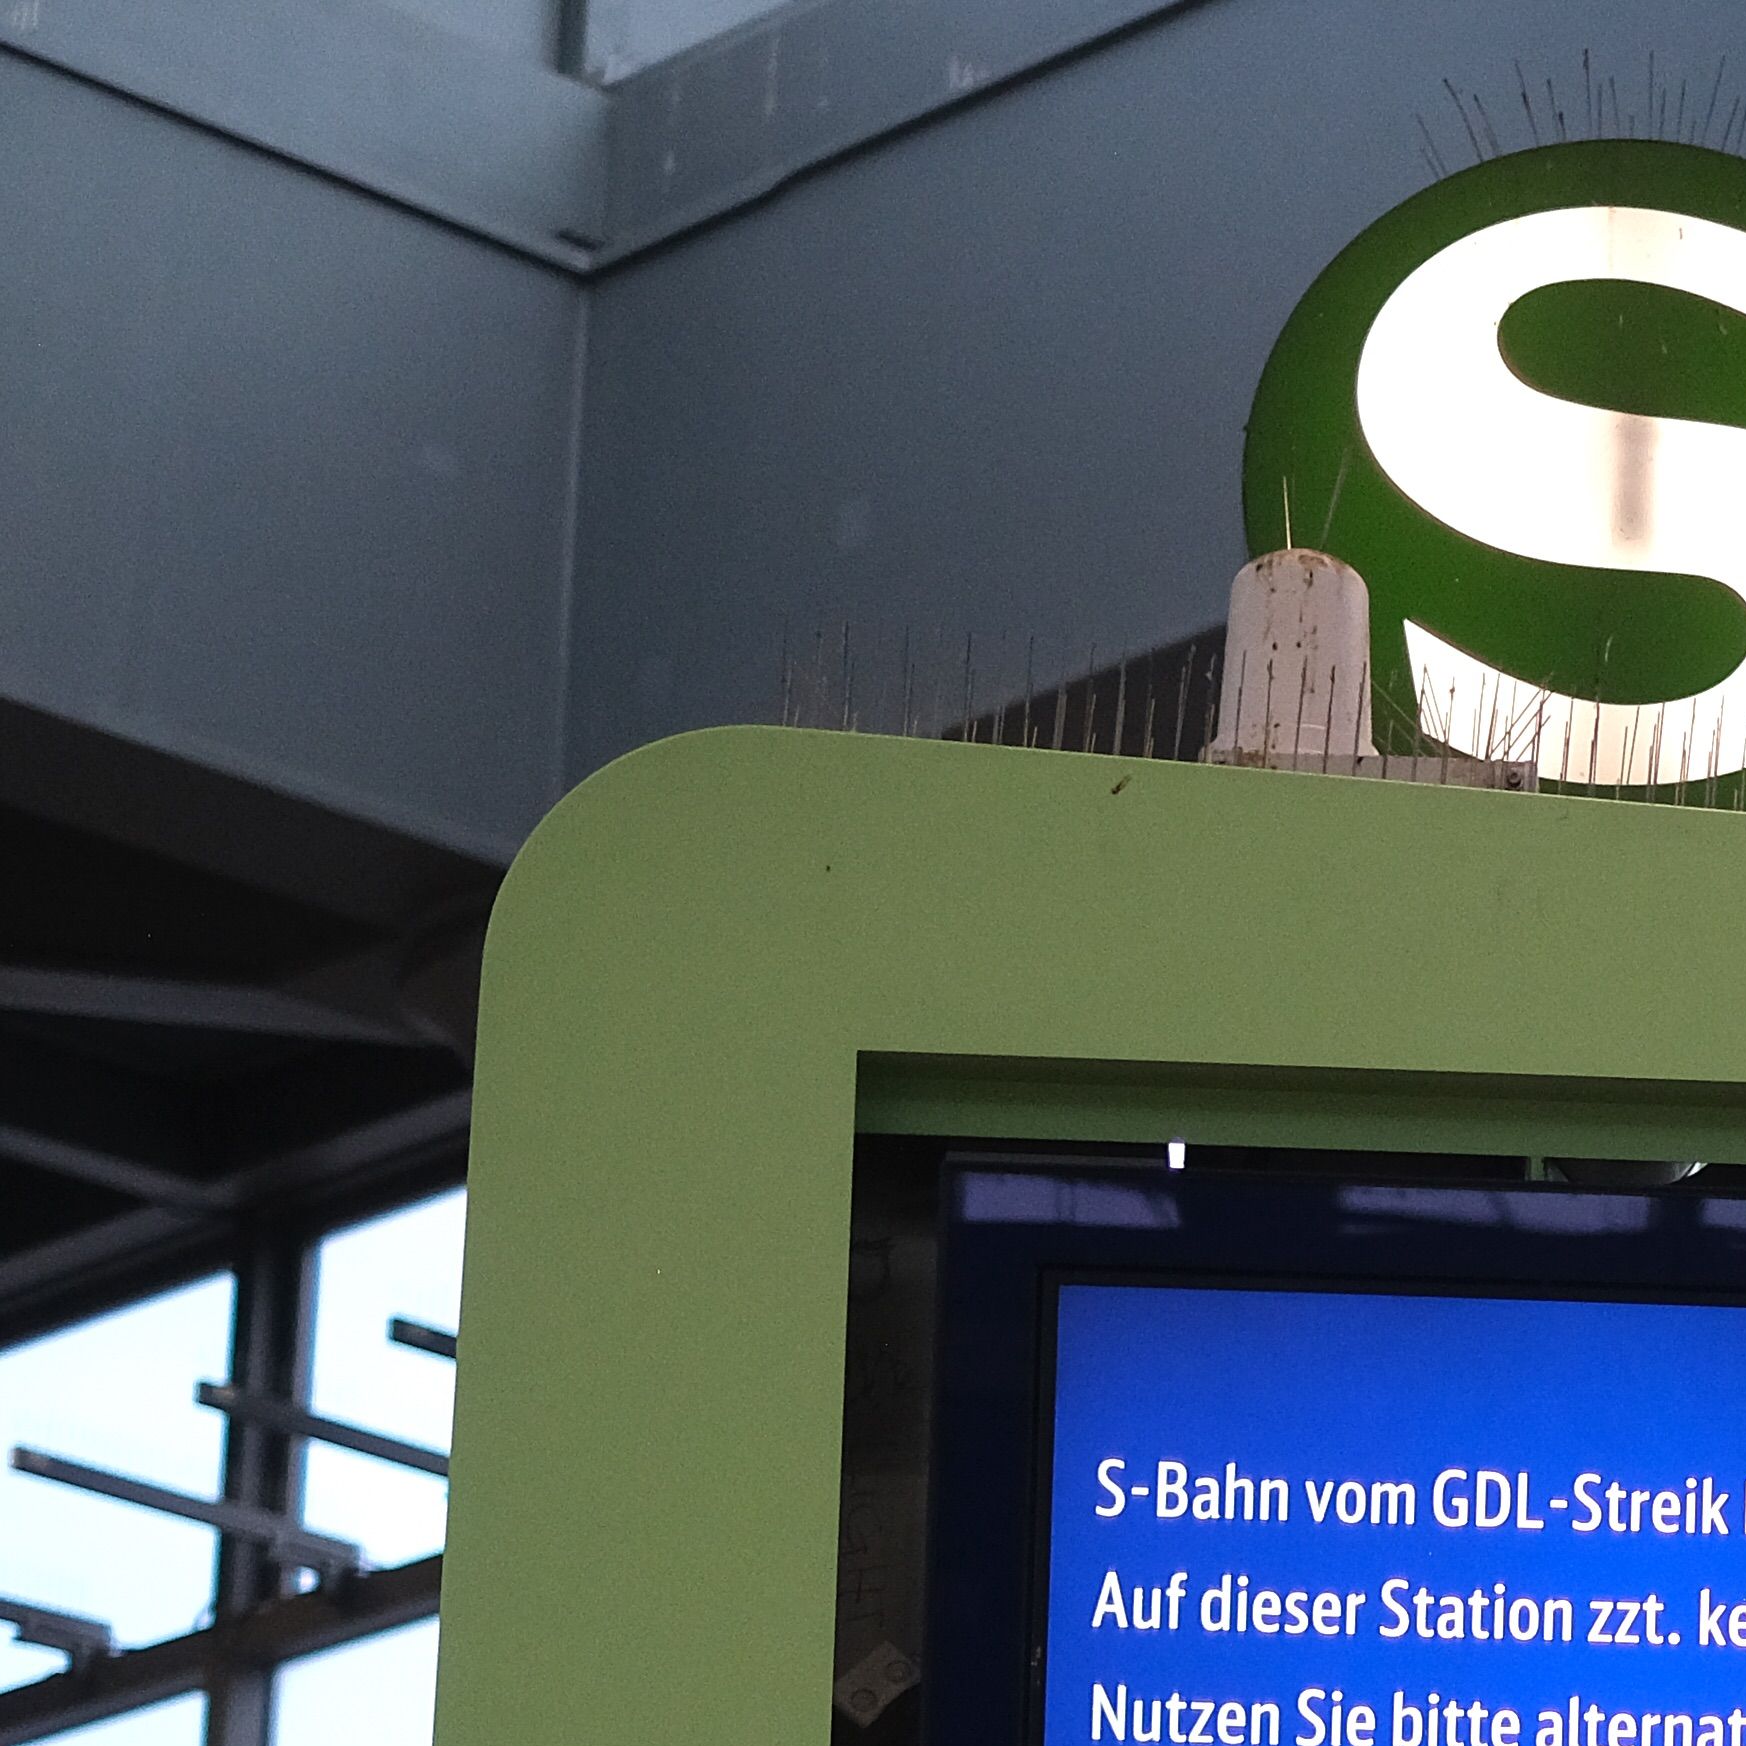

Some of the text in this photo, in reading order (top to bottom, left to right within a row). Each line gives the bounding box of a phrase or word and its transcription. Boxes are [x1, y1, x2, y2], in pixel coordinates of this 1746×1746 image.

[1095, 1458, 1289, 1521] S-Bahn
[1305, 1480, 1416, 1525] vom
[1432, 1468, 1729, 1535] GDL-Streik
[1091, 1571, 1188, 1630] Auf
[1200, 1574, 1366, 1636] dieser
[1379, 1578, 1573, 1642] Station
[1587, 1594, 1681, 1645] zzt.
[1091, 1683, 1280, 1746] Nutzen
